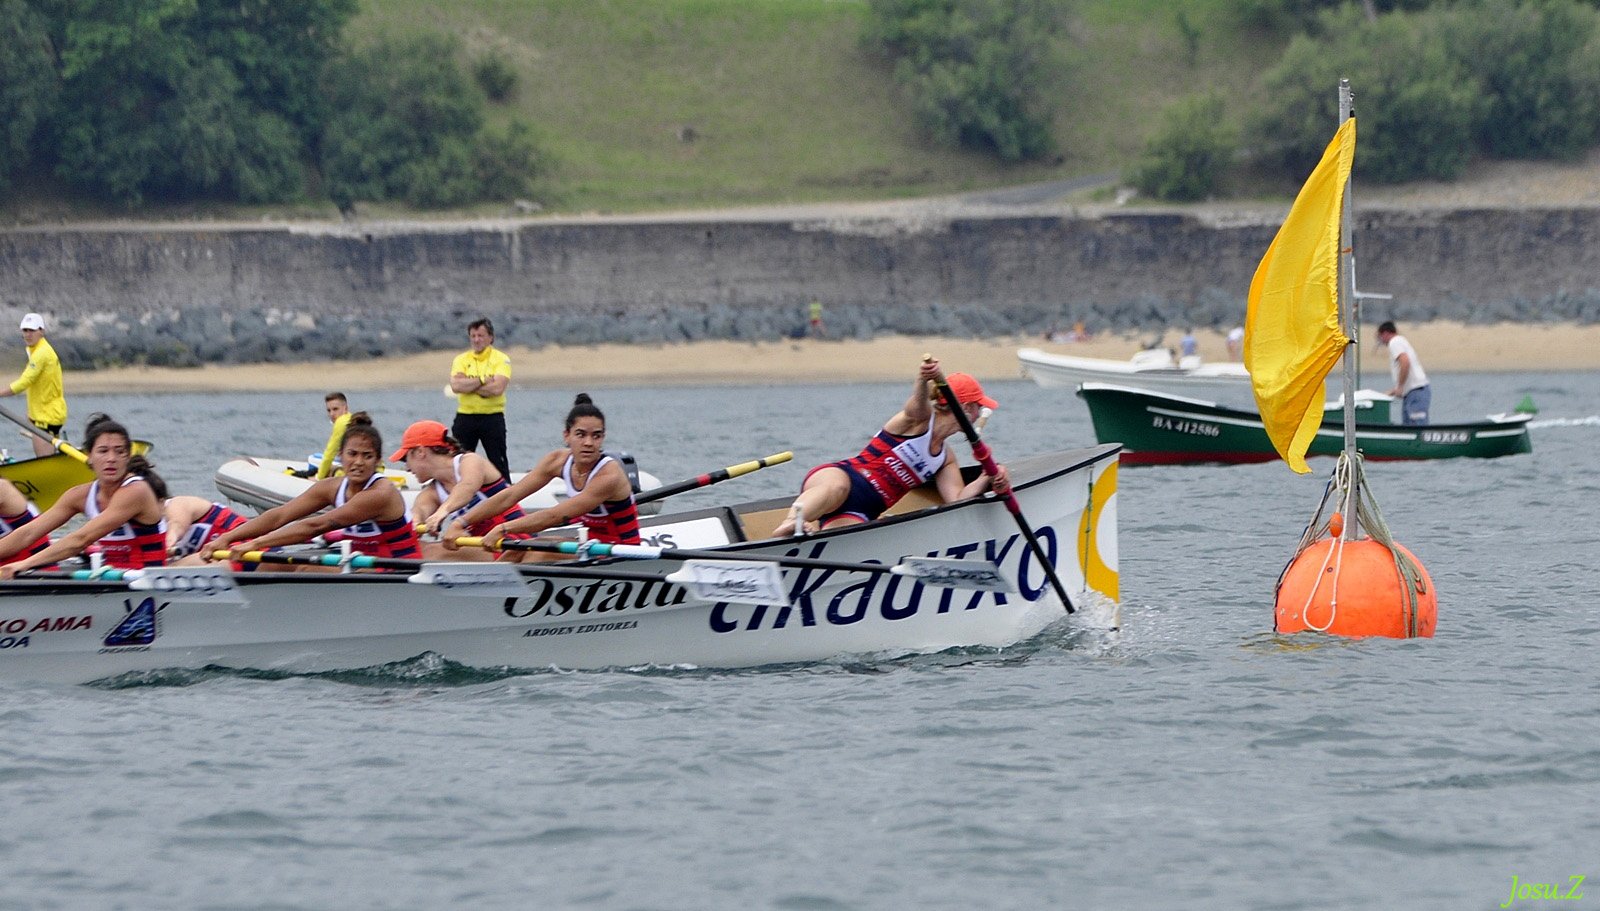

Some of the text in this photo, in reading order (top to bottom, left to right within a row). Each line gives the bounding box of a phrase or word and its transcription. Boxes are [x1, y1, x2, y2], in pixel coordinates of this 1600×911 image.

[1153, 416, 1172, 430] BA
[29, 615, 93, 633] AMA
[522, 621, 639, 638] ARDOEN EDITOREA
